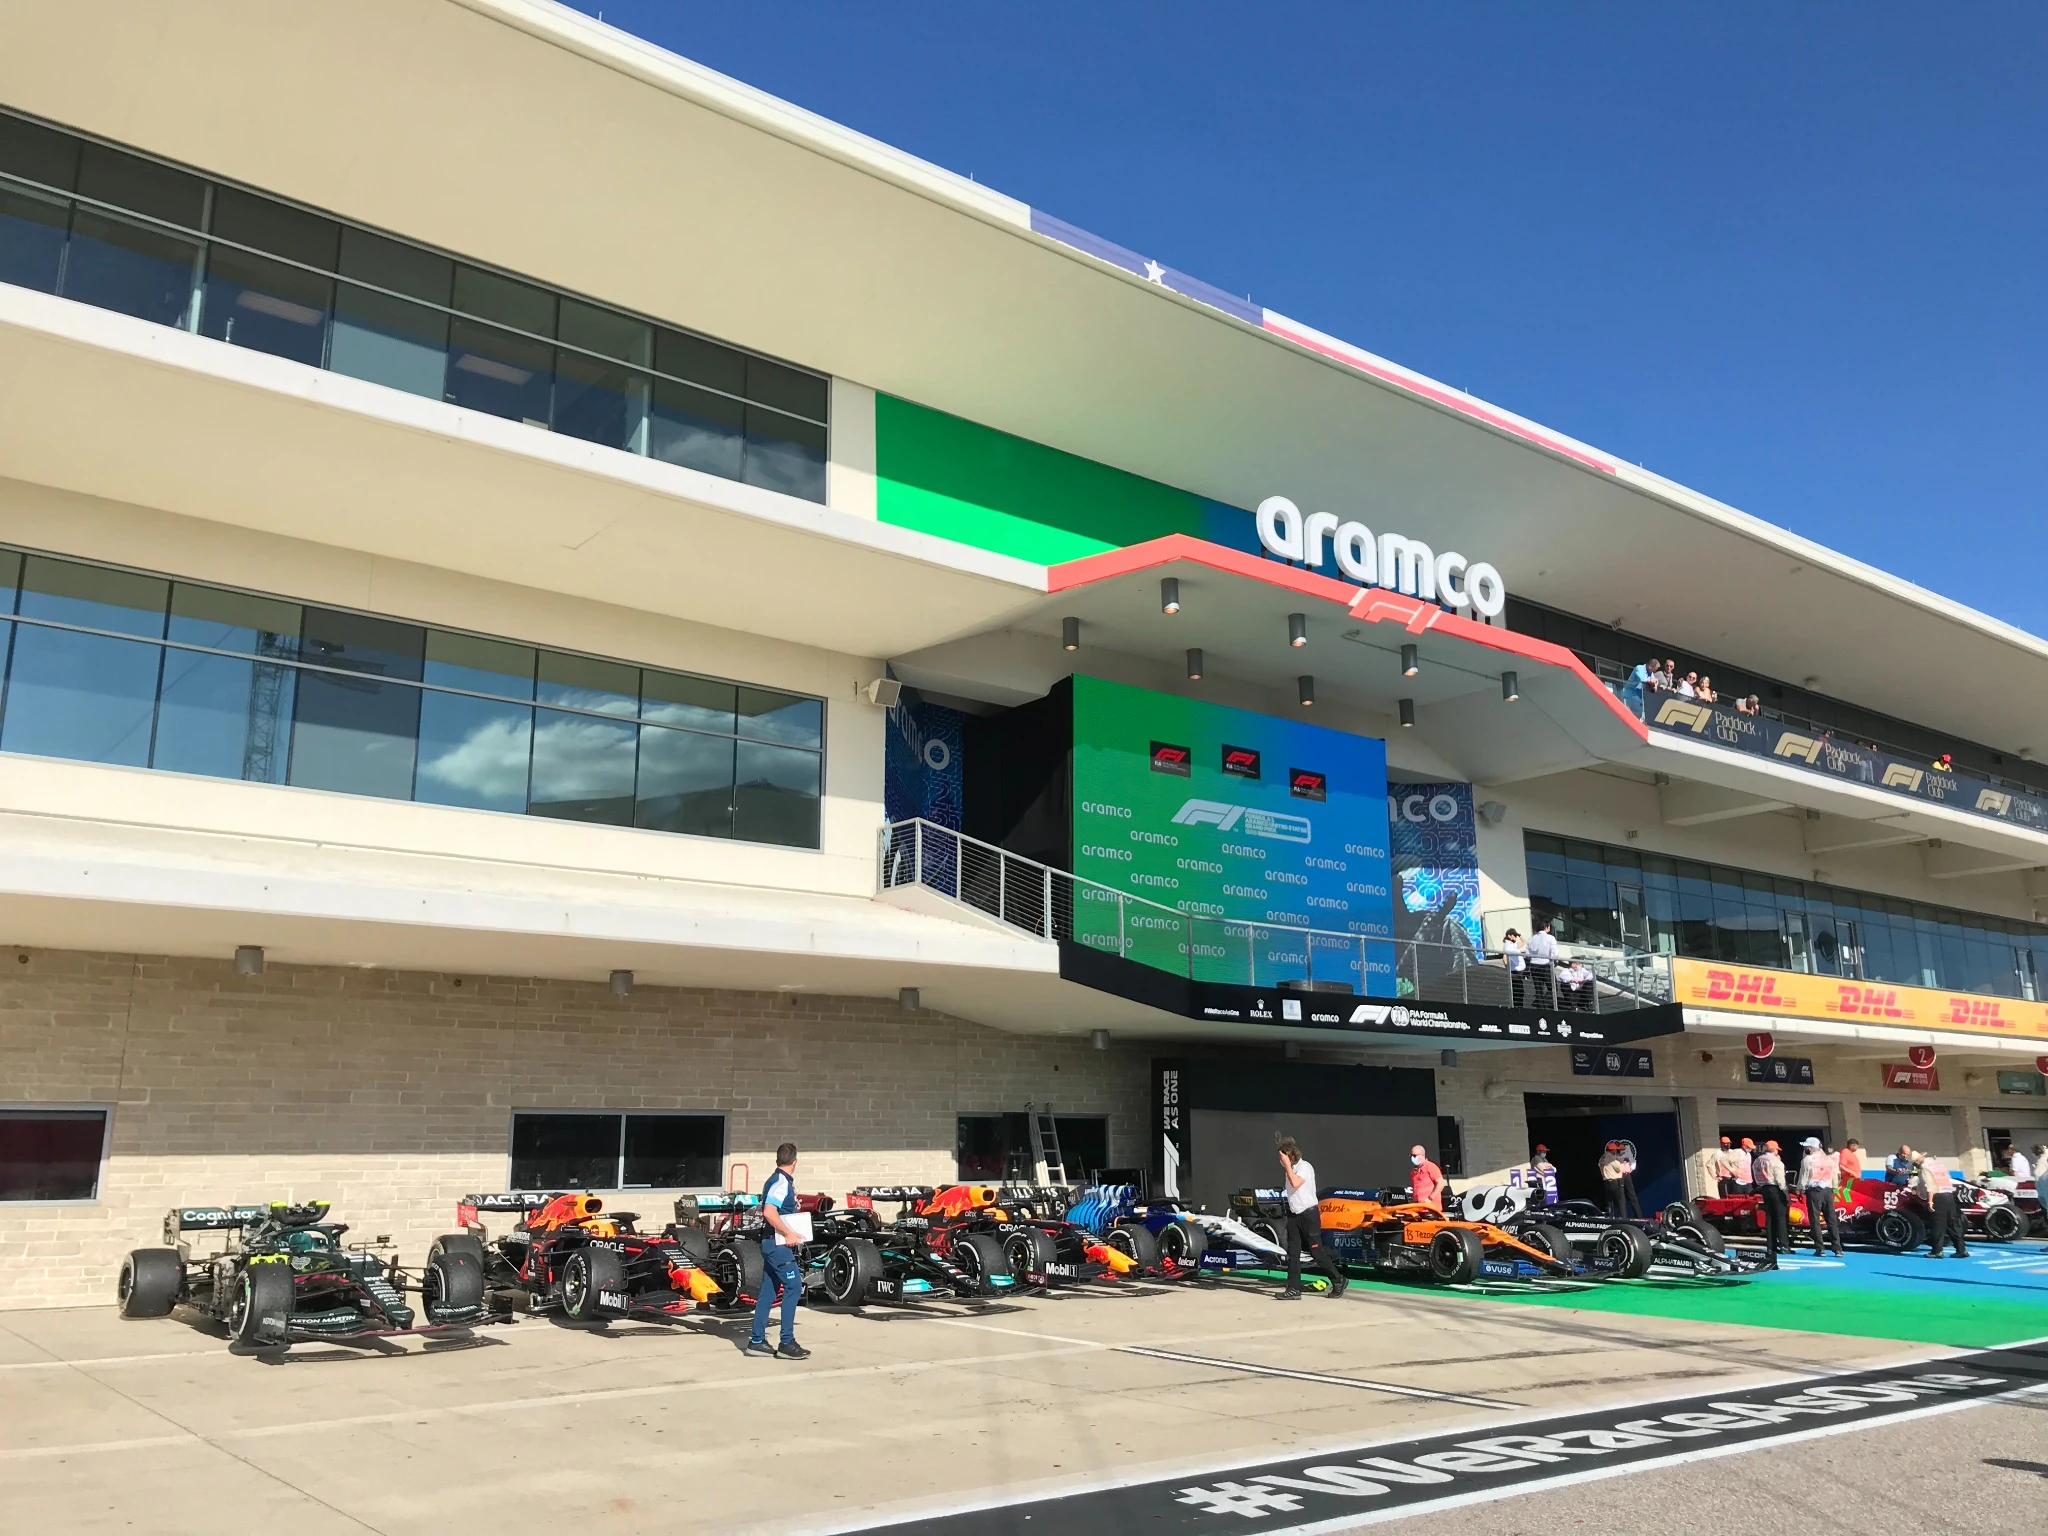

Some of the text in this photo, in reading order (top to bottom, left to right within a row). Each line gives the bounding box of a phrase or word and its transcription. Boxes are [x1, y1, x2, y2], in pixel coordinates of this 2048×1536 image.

[1256, 496, 1505, 616] aramco
[1715, 711, 1756, 736] Paddock
[1716, 725, 1738, 743] Club
[1825, 743, 1862, 765] Paddock
[1826, 756, 1845, 772] Club
[1925, 772, 1957, 792] Paddock
[1928, 784, 1944, 799] Club
[1082, 801, 1132, 818] aramco
[1130, 830, 1178, 846] aramco
[1082, 845, 1132, 861] aramco
[1221, 843, 1266, 859] aramco
[1345, 843, 1385, 859] aramco
[1177, 858, 1223, 873] aramco
[1305, 856, 1346, 871] aramco
[1131, 873, 1179, 888] aramco
[1265, 870, 1308, 885] aramco
[1223, 884, 1267, 899] aramco
[1347, 881, 1386, 896] aramco
[1177, 900, 1224, 915] aramco
[1306, 896, 1348, 910] aramco
[1131, 916, 1180, 931] aramco
[1267, 910, 1309, 925] aramco
[1348, 920, 1388, 934] aramco
[1707, 969, 1782, 1006] DHL
[1838, 985, 1902, 1017] DHL
[1250, 1009, 1273, 1019] ROLEX
[1311, 1013, 1339, 1023] aramco
[1409, 1010, 1448, 1020] FIA Formula 1
[1949, 998, 2005, 1027] DHL
[1409, 1019, 1429, 1027] World
[1756, 1035, 1763, 1052] 1
[1918, 1048, 1927, 1063] 2
[1163, 1107, 1171, 1129] WE
[1171, 1107, 1179, 1129] AS
[1545, 1176, 1557, 1191] 2
[1883, 1191, 1899, 1205] 55
[1834, 1205, 1871, 1223] Ray-Ban
[590, 1240, 625, 1253] ORACLE
[838, 1244, 854, 1264] ZERO
[1178, 1256, 1196, 1267] telcel
[1204, 1255, 1228, 1264] Acronis
[1654, 1257, 1692, 1267] ALPHATAURI
[1737, 1251, 1766, 1259] EPICOR
[1045, 1262, 1070, 1276] Mobil
[877, 1280, 895, 1294] IWC
[600, 1291, 621, 1308] Mobil
[322, 1315, 356, 1323] MARTIN
[1174, 1373, 2008, 1518] #WeRaceAsOne
